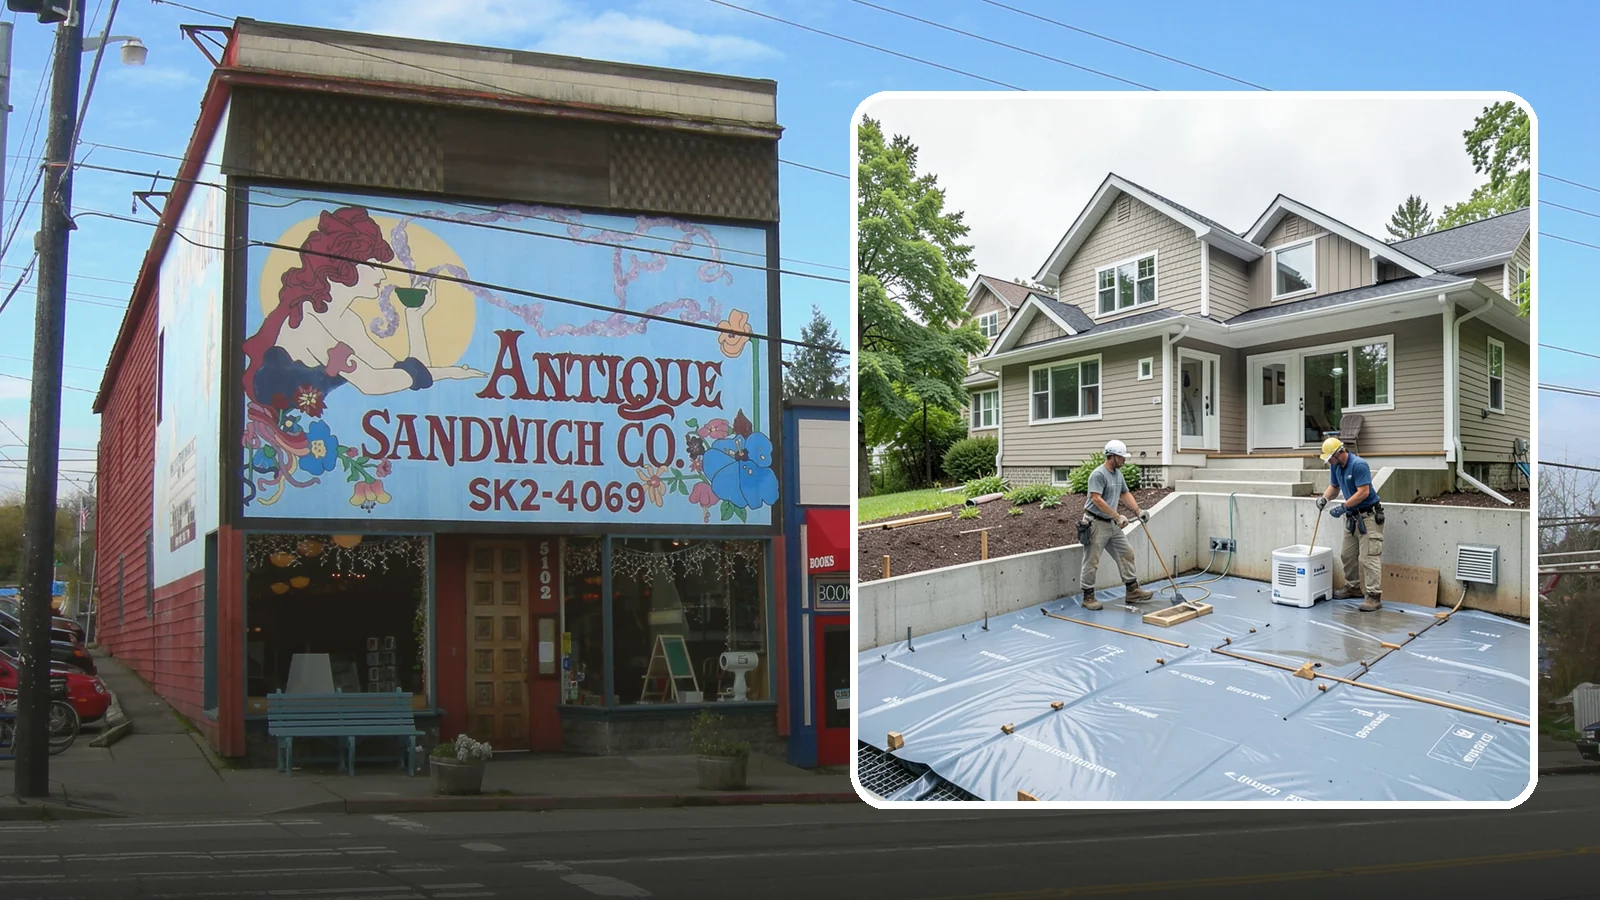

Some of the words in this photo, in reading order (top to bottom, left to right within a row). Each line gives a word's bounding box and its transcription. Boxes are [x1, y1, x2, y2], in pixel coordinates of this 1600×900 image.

[476, 329, 723, 420] ANTIQUE
[361, 408, 604, 467] SANDWICH
[616, 422, 685, 468] CO.
[468, 477, 646, 513] SK2-4069
[539, 541, 552, 600] 5102
[809, 555, 835, 569] BOOKS
